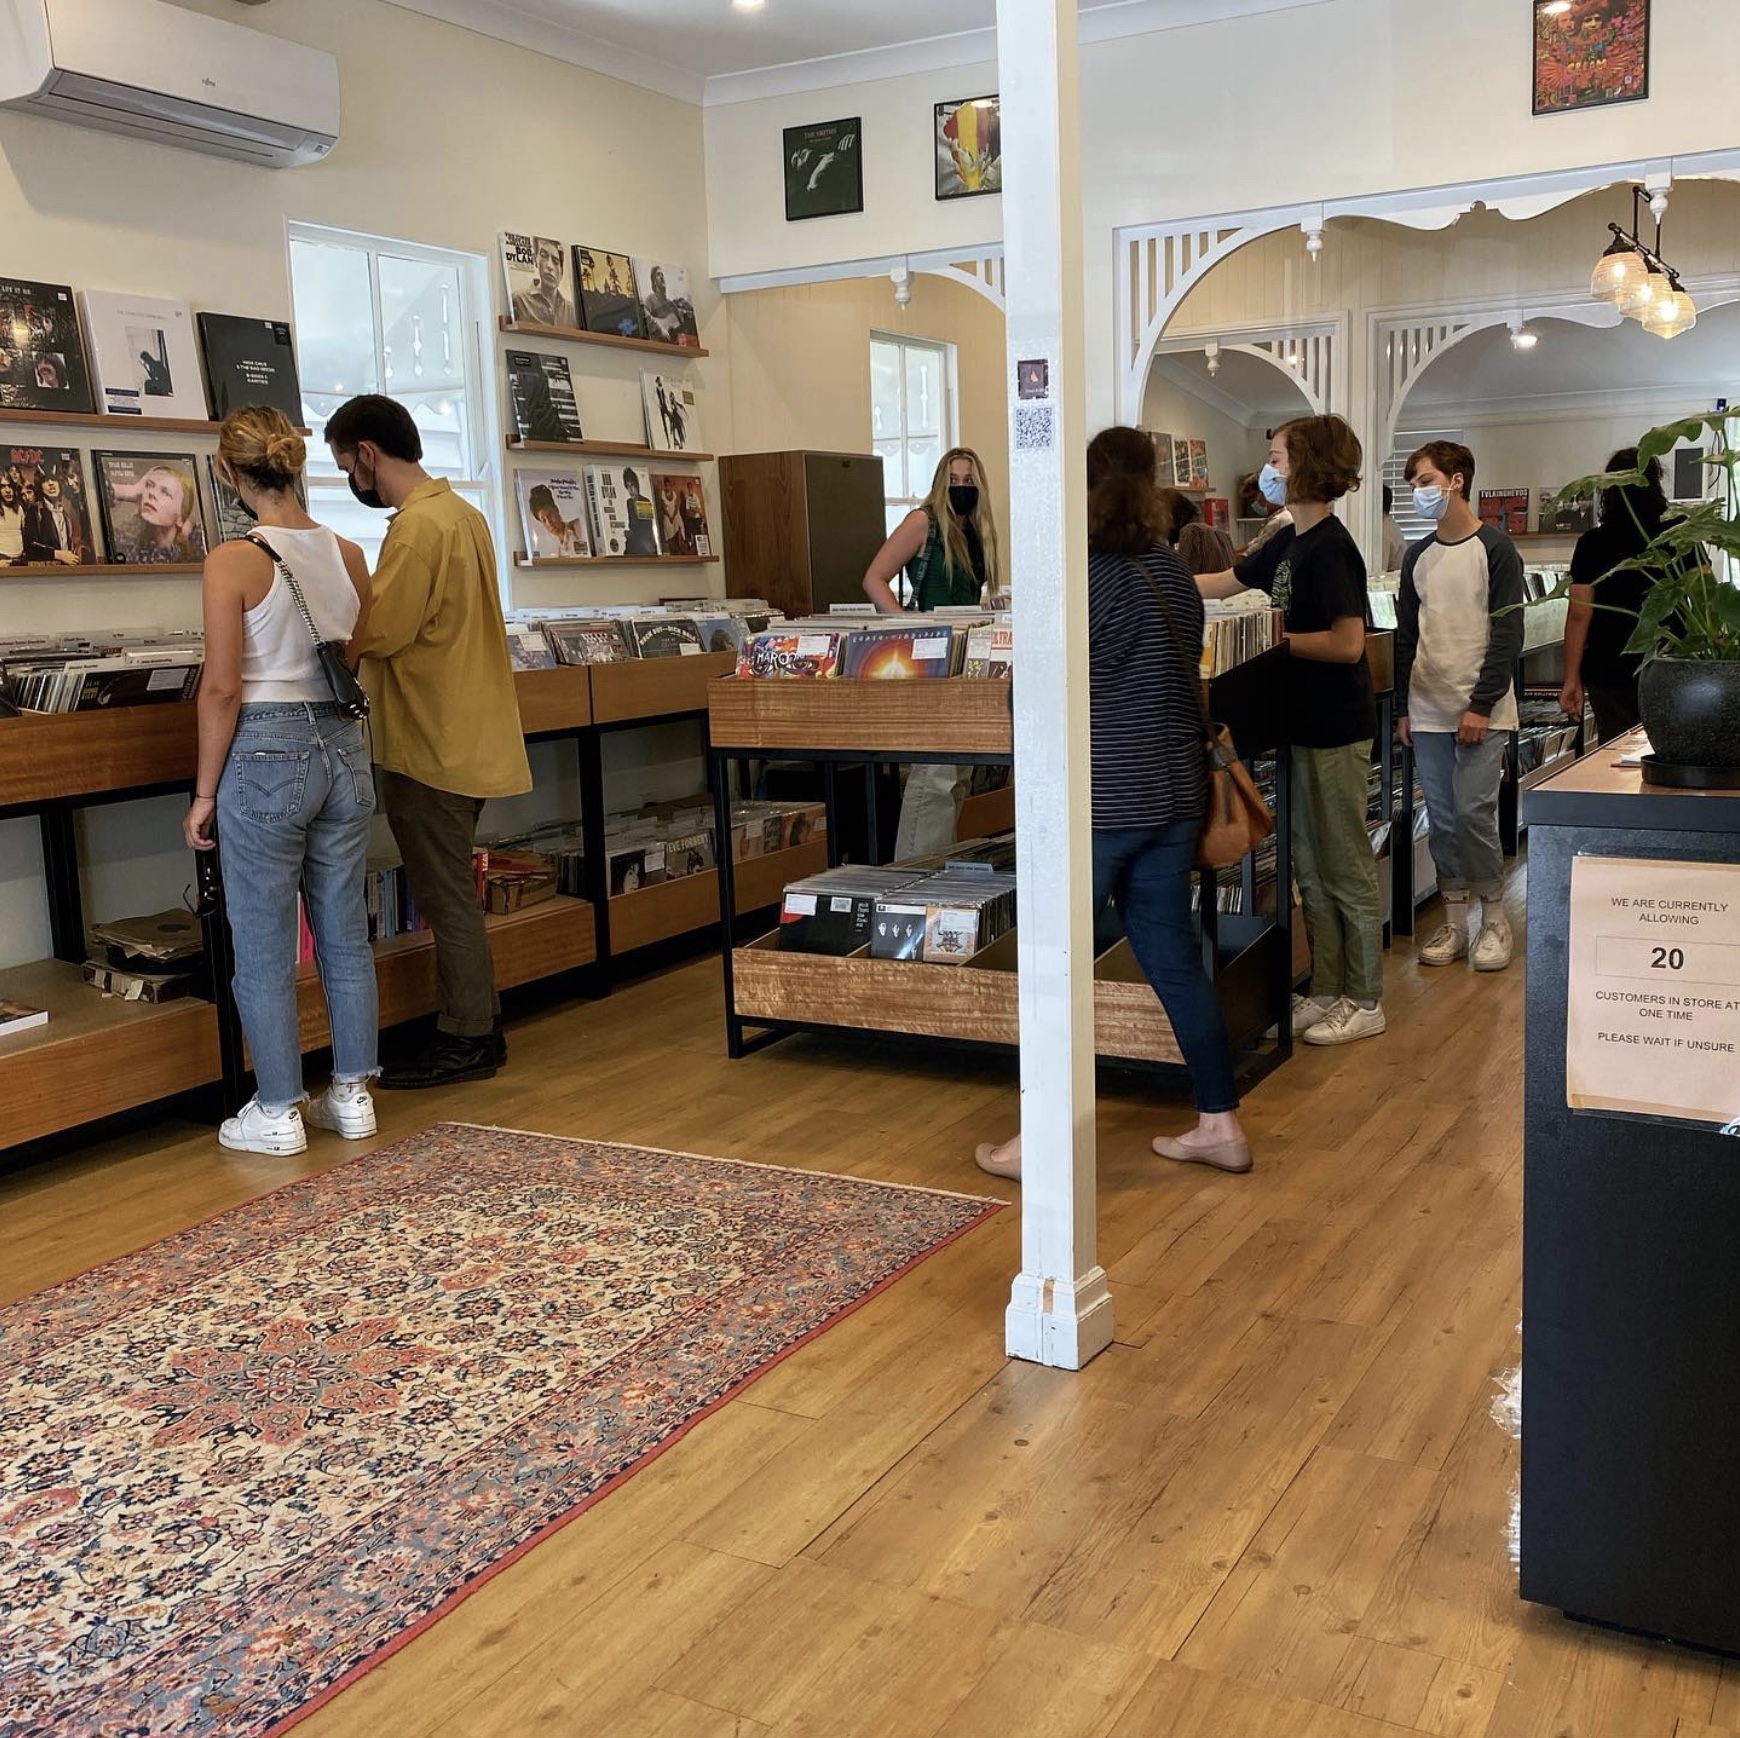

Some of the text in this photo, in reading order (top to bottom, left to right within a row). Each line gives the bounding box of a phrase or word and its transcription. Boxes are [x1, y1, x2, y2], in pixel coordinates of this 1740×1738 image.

[1611, 897, 1728, 912] WE ARE CURRENTLY
[1639, 913, 1700, 925] ALLOWING
[1651, 946, 1684, 970] 20
[1595, 990, 1740, 1011] CUSTOMERS IN STORE AT
[1639, 1008, 1693, 1021] ONE TIME
[1597, 1032, 1736, 1053] PLEASE WAIT IF UNSURE
